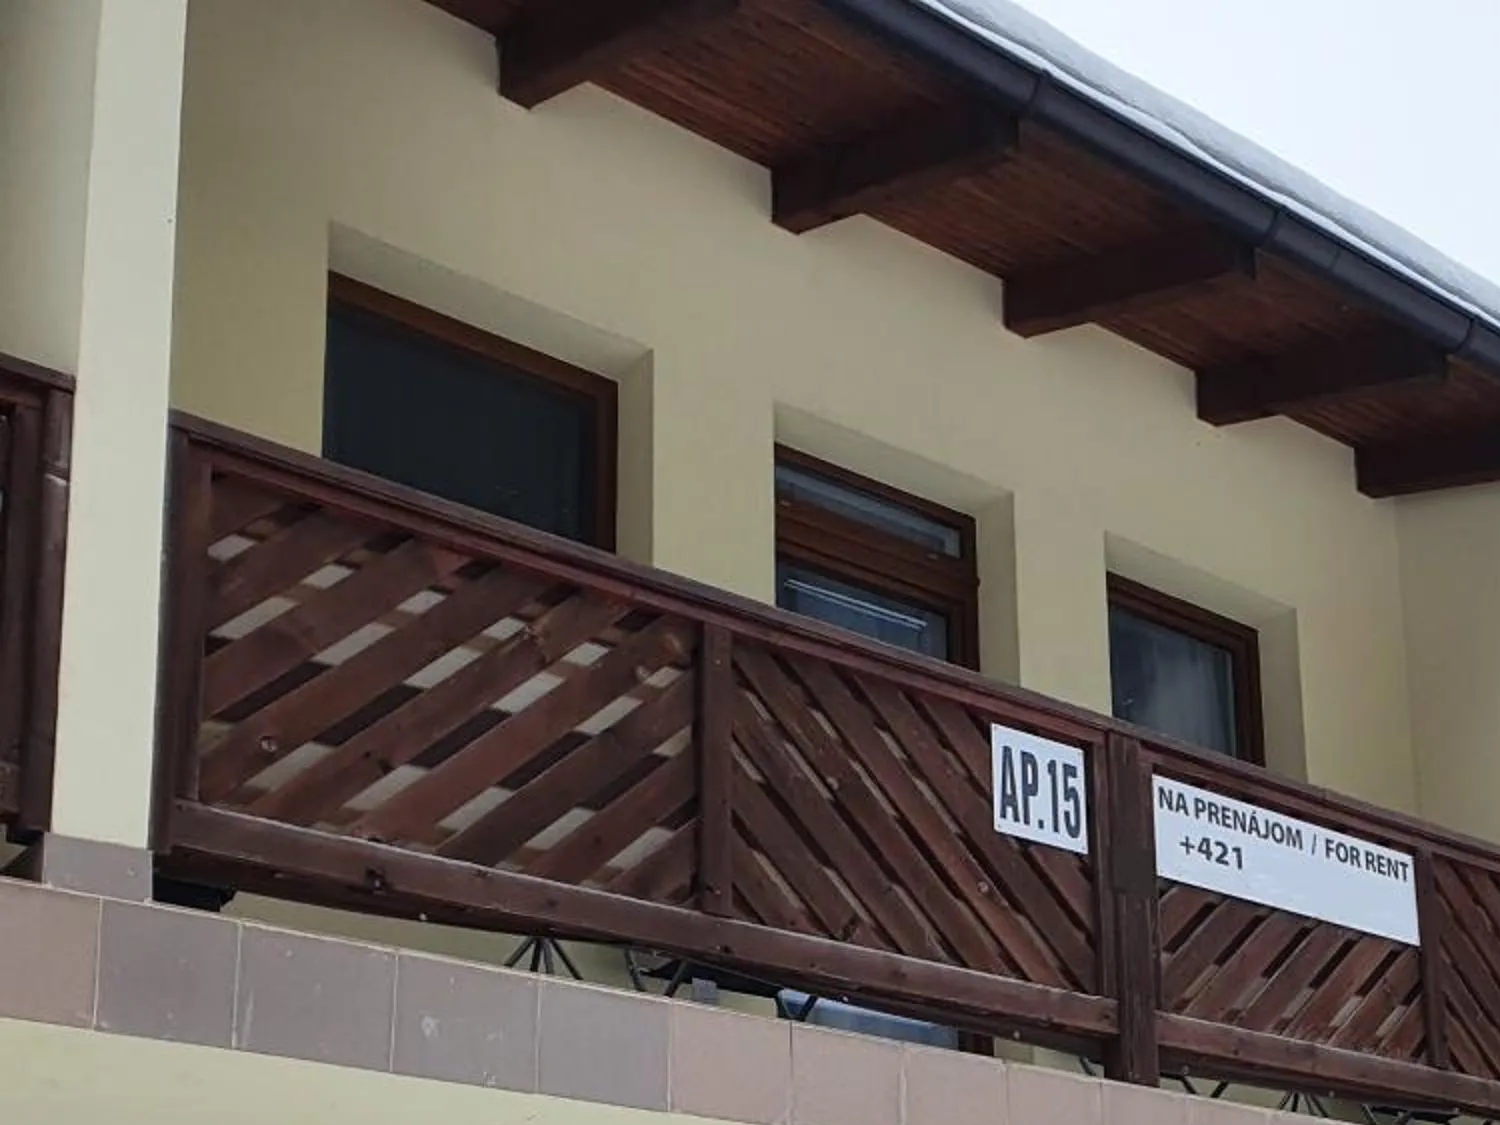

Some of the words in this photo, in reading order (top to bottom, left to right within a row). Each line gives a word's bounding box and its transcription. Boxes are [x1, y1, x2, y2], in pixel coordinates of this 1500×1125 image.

[999, 745, 1081, 839] AP.15
[1158, 786, 1189, 817] NA
[1193, 797, 1303, 850] PRENÁJOM
[1311, 833, 1317, 855] /
[1325, 838, 1361, 868] FOR
[1364, 850, 1409, 882] RENT
[1179, 836, 1243, 870] +421
